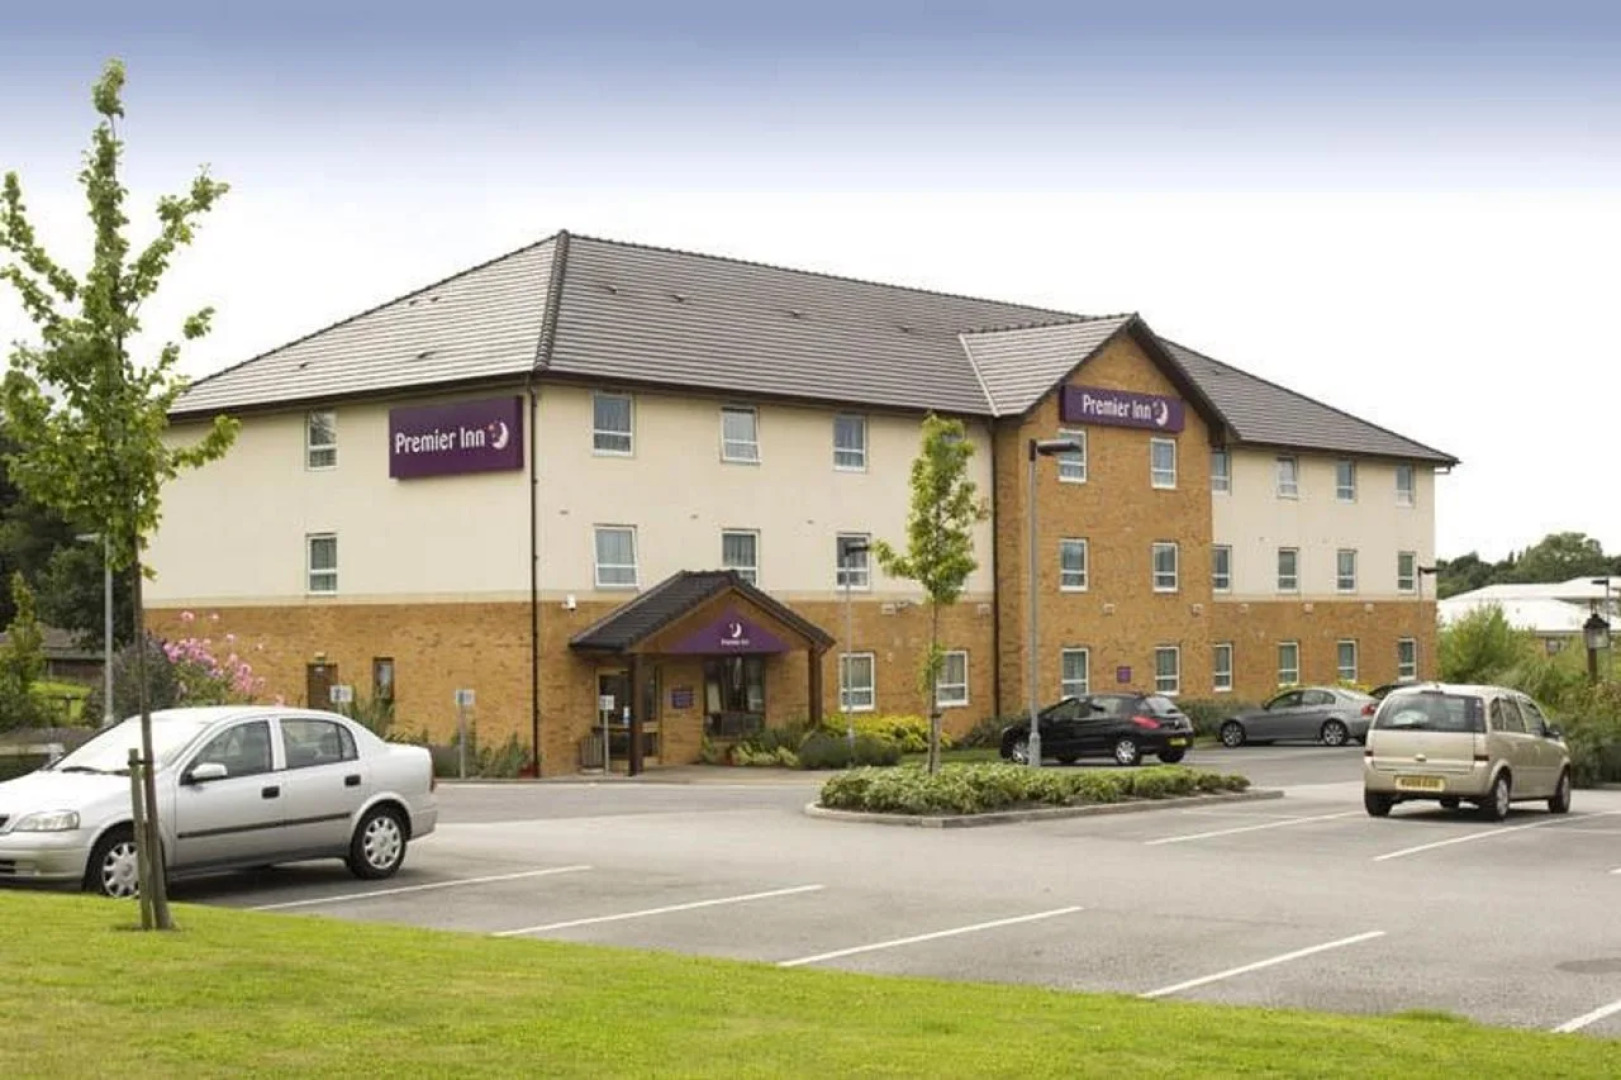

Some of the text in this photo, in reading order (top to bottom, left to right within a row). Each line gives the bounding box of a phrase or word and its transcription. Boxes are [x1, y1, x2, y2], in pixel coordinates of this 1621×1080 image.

[1082, 394, 1152, 420] Premier Inn
[395, 426, 485, 454] Premier Inn
